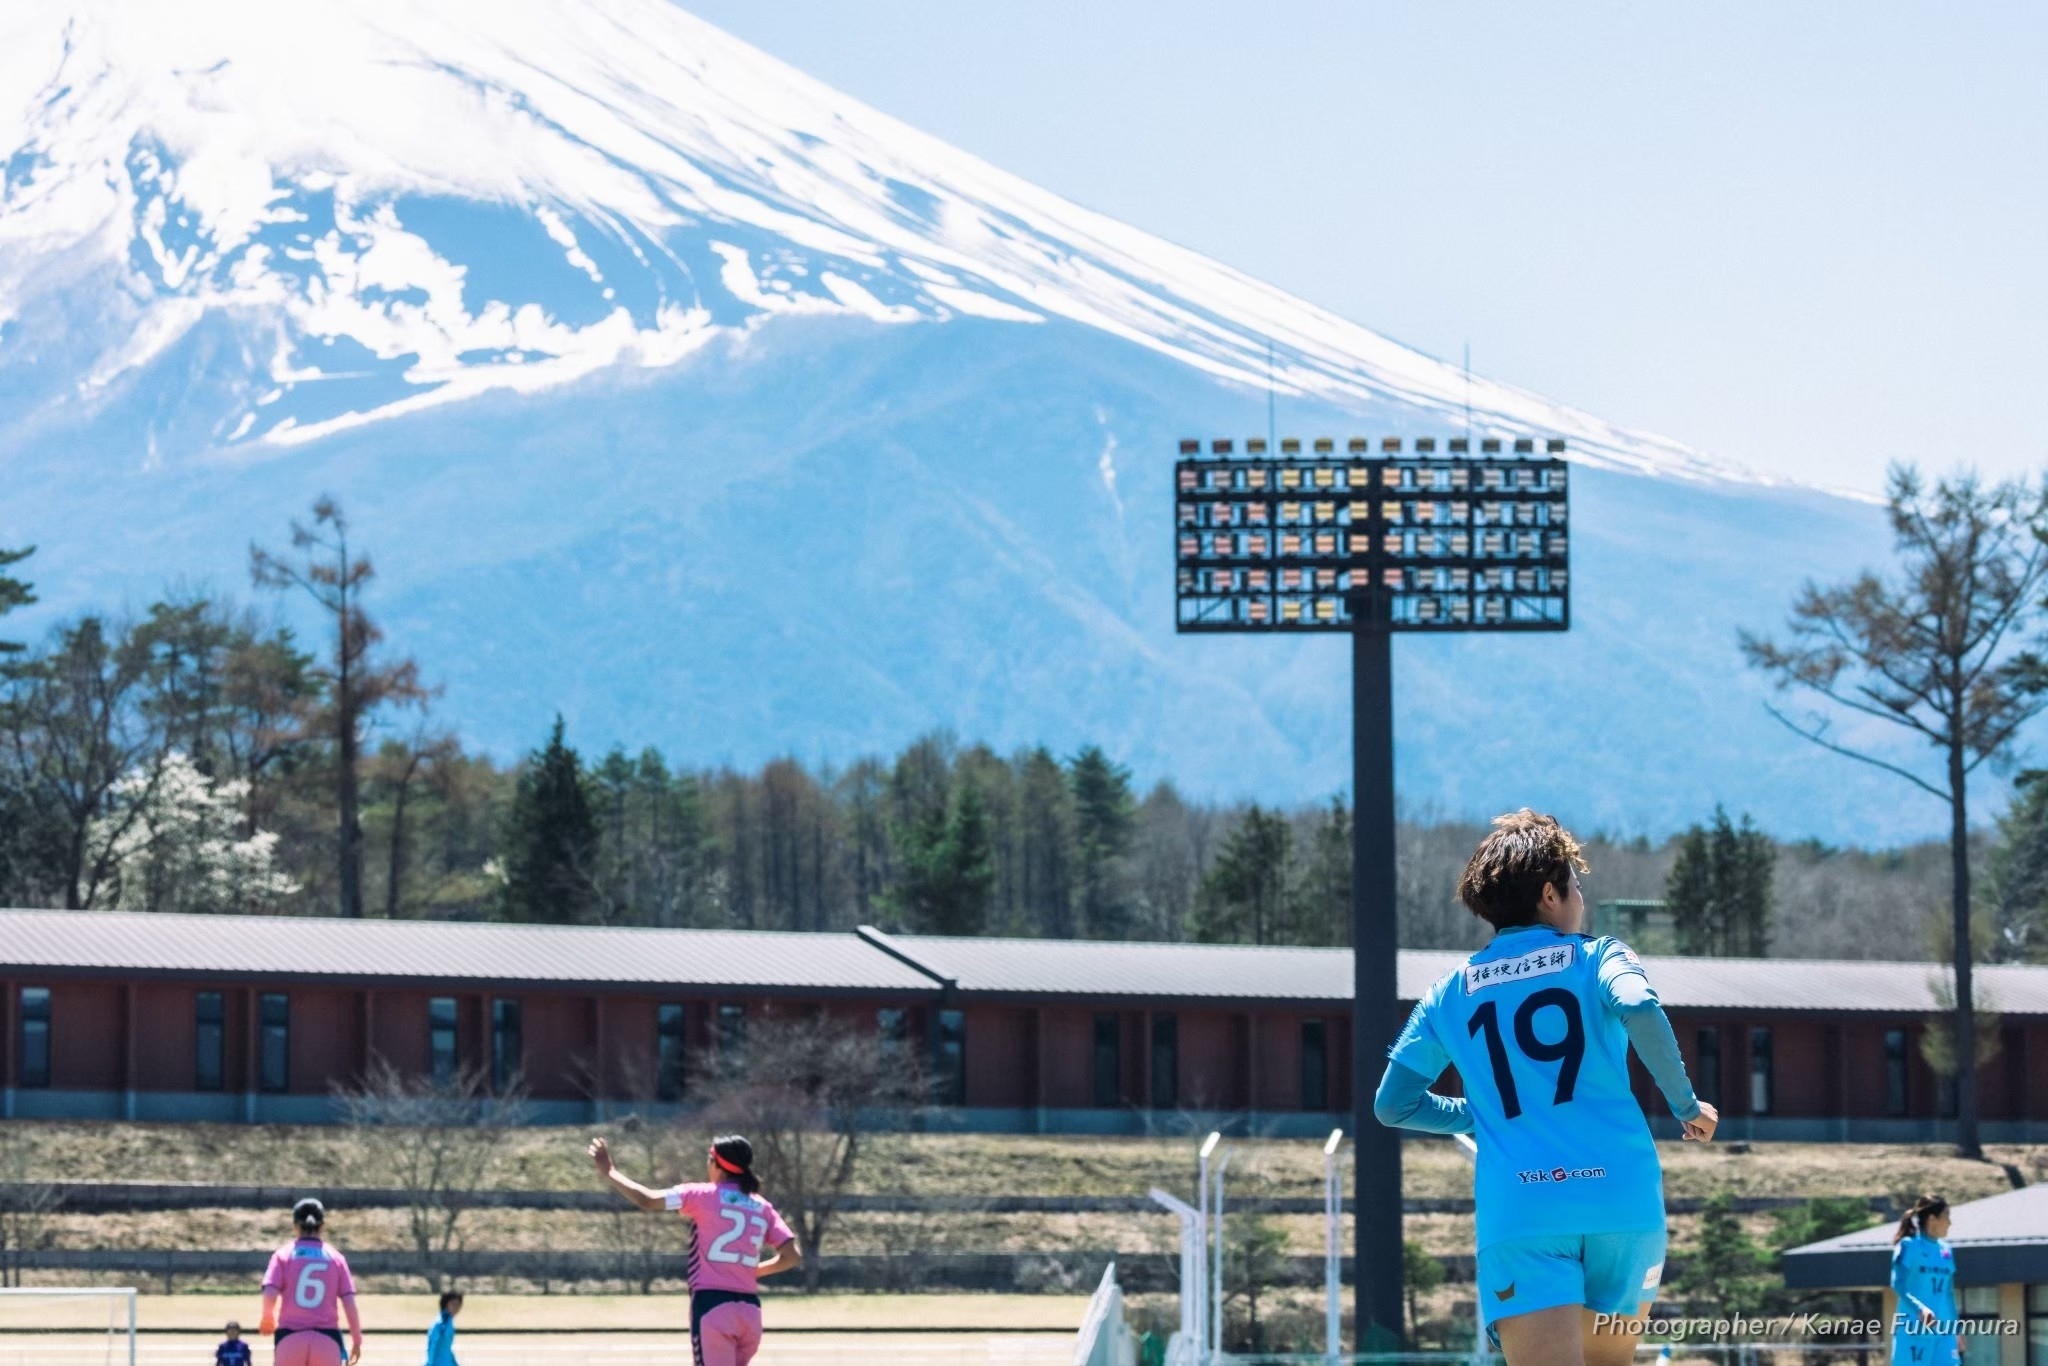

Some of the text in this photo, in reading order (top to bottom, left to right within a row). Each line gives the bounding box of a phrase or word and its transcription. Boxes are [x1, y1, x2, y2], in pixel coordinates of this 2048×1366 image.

[1472, 951, 1567, 983] 桔梗信玄餅
[1467, 987, 1586, 1121] 19
[707, 1208, 768, 1268] 23
[295, 1262, 328, 1309] 6
[1931, 1276, 1945, 1295] 14
